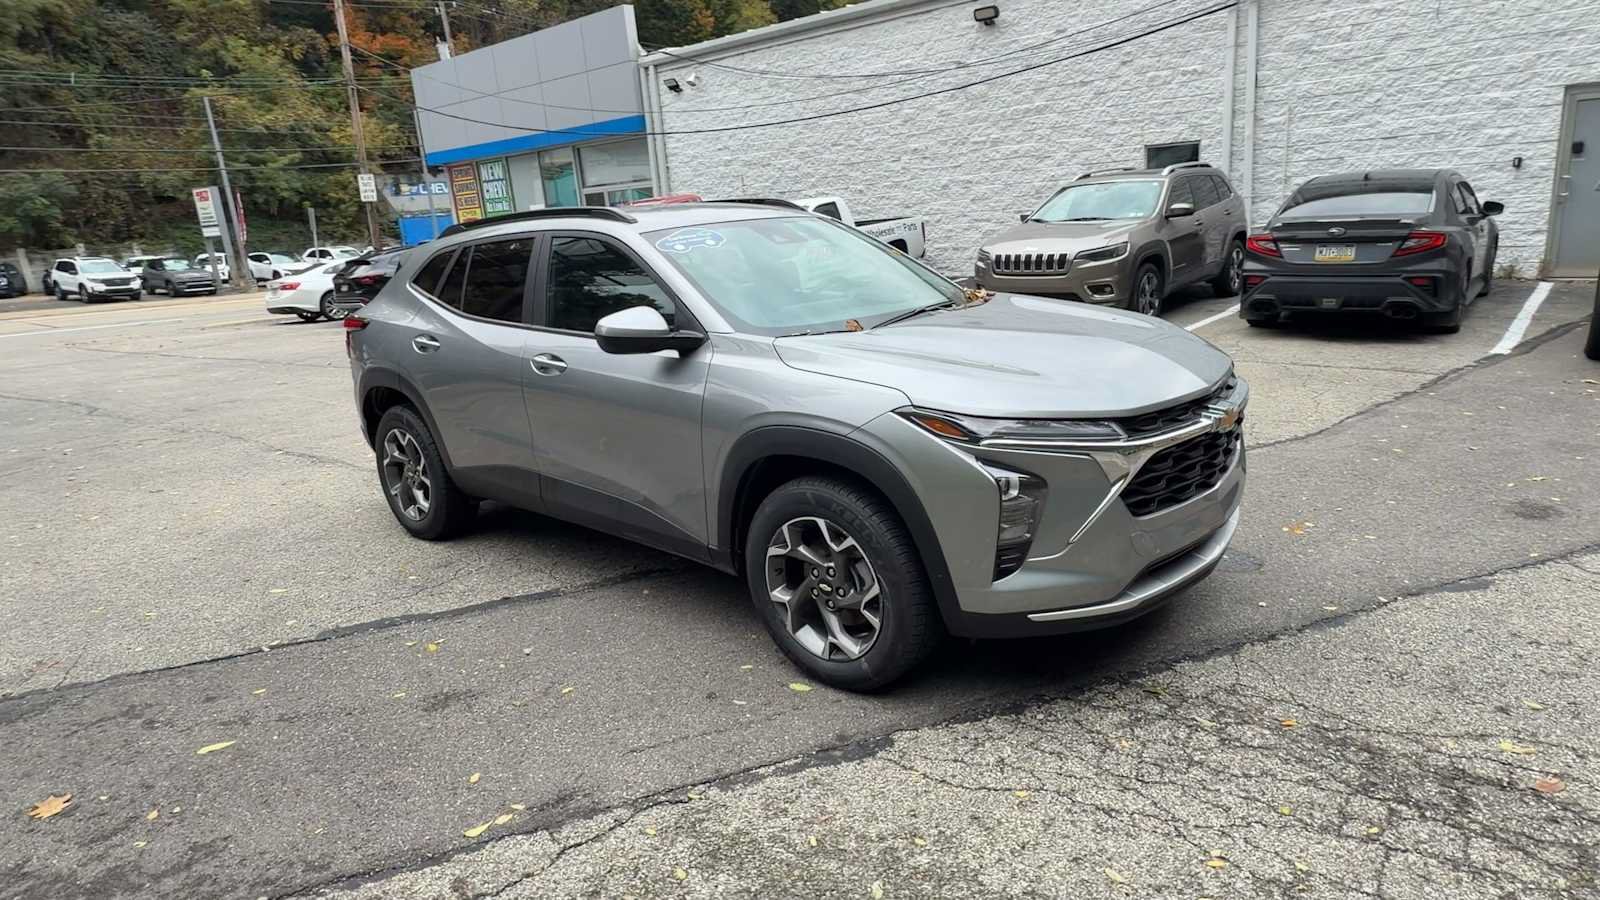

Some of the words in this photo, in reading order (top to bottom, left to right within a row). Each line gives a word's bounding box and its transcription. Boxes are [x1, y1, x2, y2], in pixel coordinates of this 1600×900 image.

[480, 161, 504, 181] NEW
[483, 180, 507, 199] CHEVY
[903, 223, 917, 232] Parts
